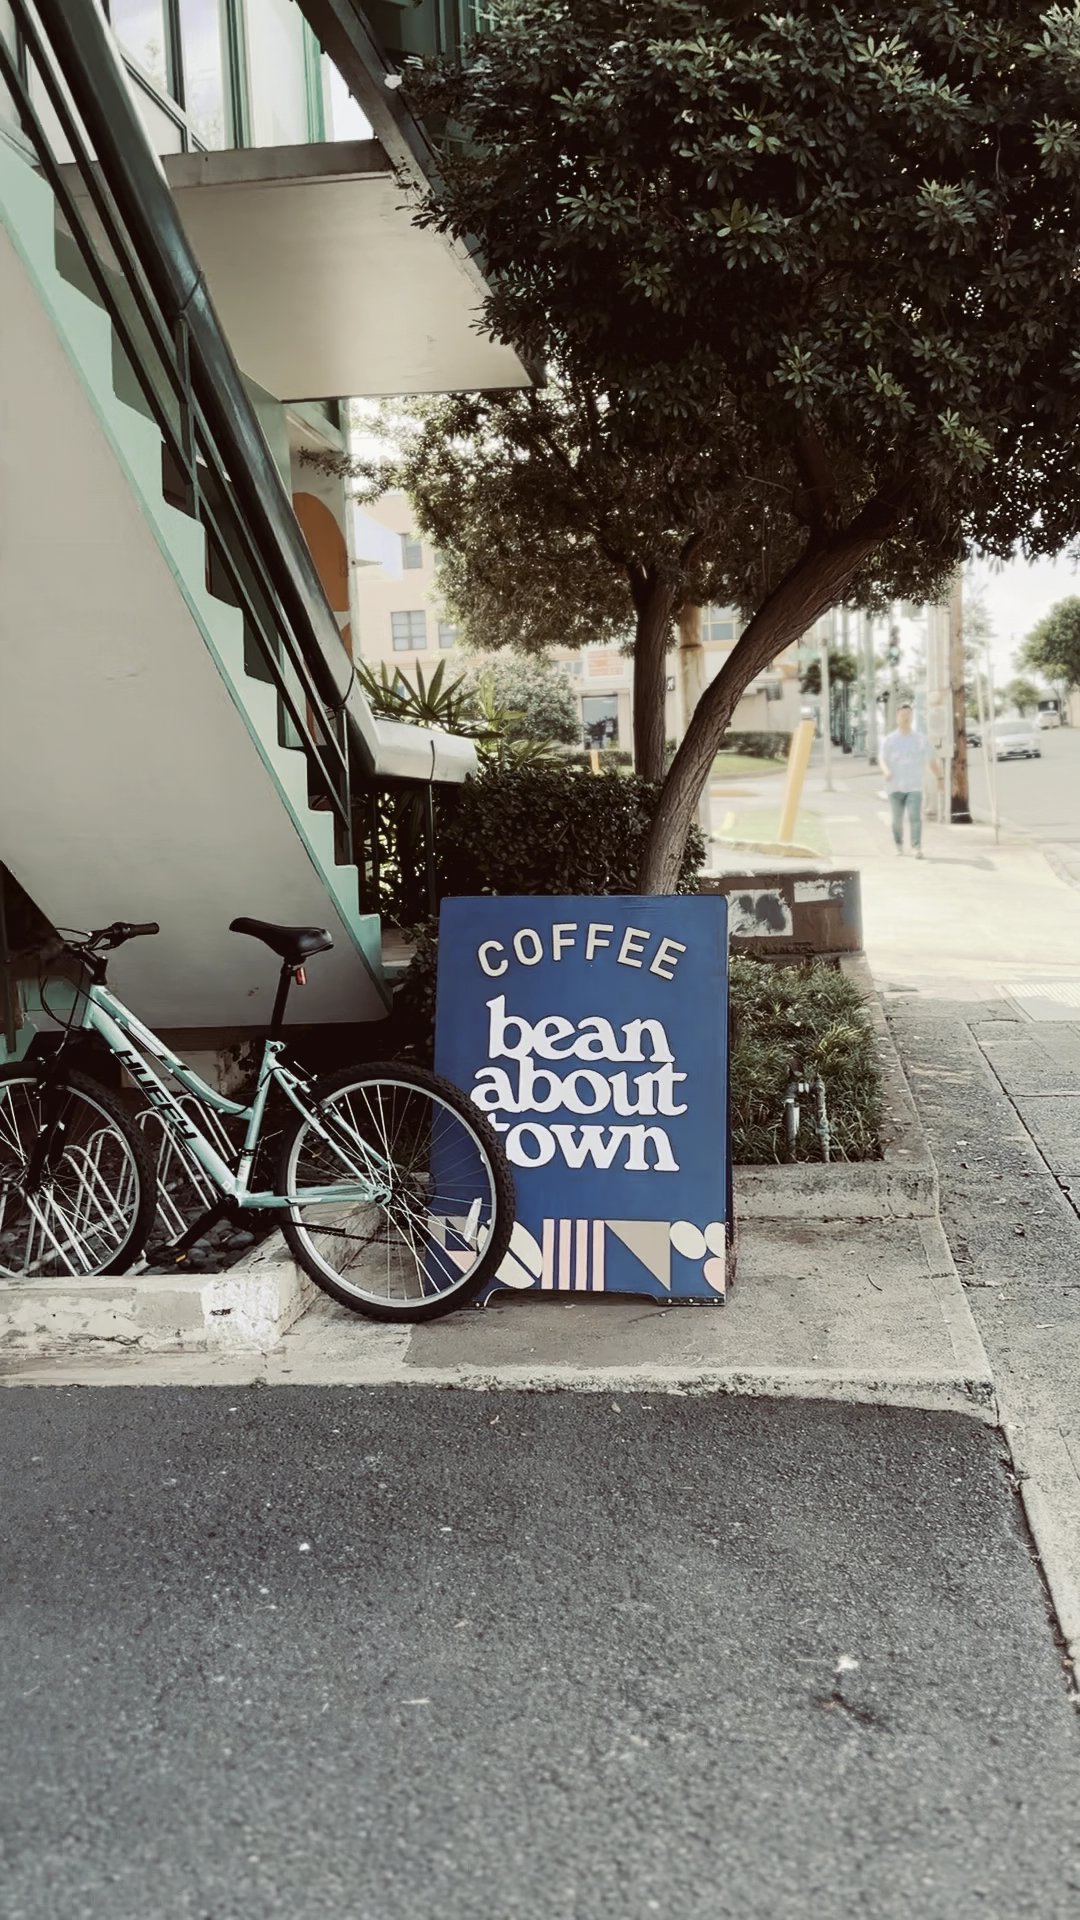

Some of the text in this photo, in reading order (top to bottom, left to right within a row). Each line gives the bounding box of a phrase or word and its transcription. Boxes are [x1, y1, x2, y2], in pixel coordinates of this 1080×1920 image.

[478, 922, 687, 980] COFFEE
[486, 994, 675, 1062] bean
[115, 1050, 198, 1139] HUFFY
[470, 1056, 688, 1117] about
